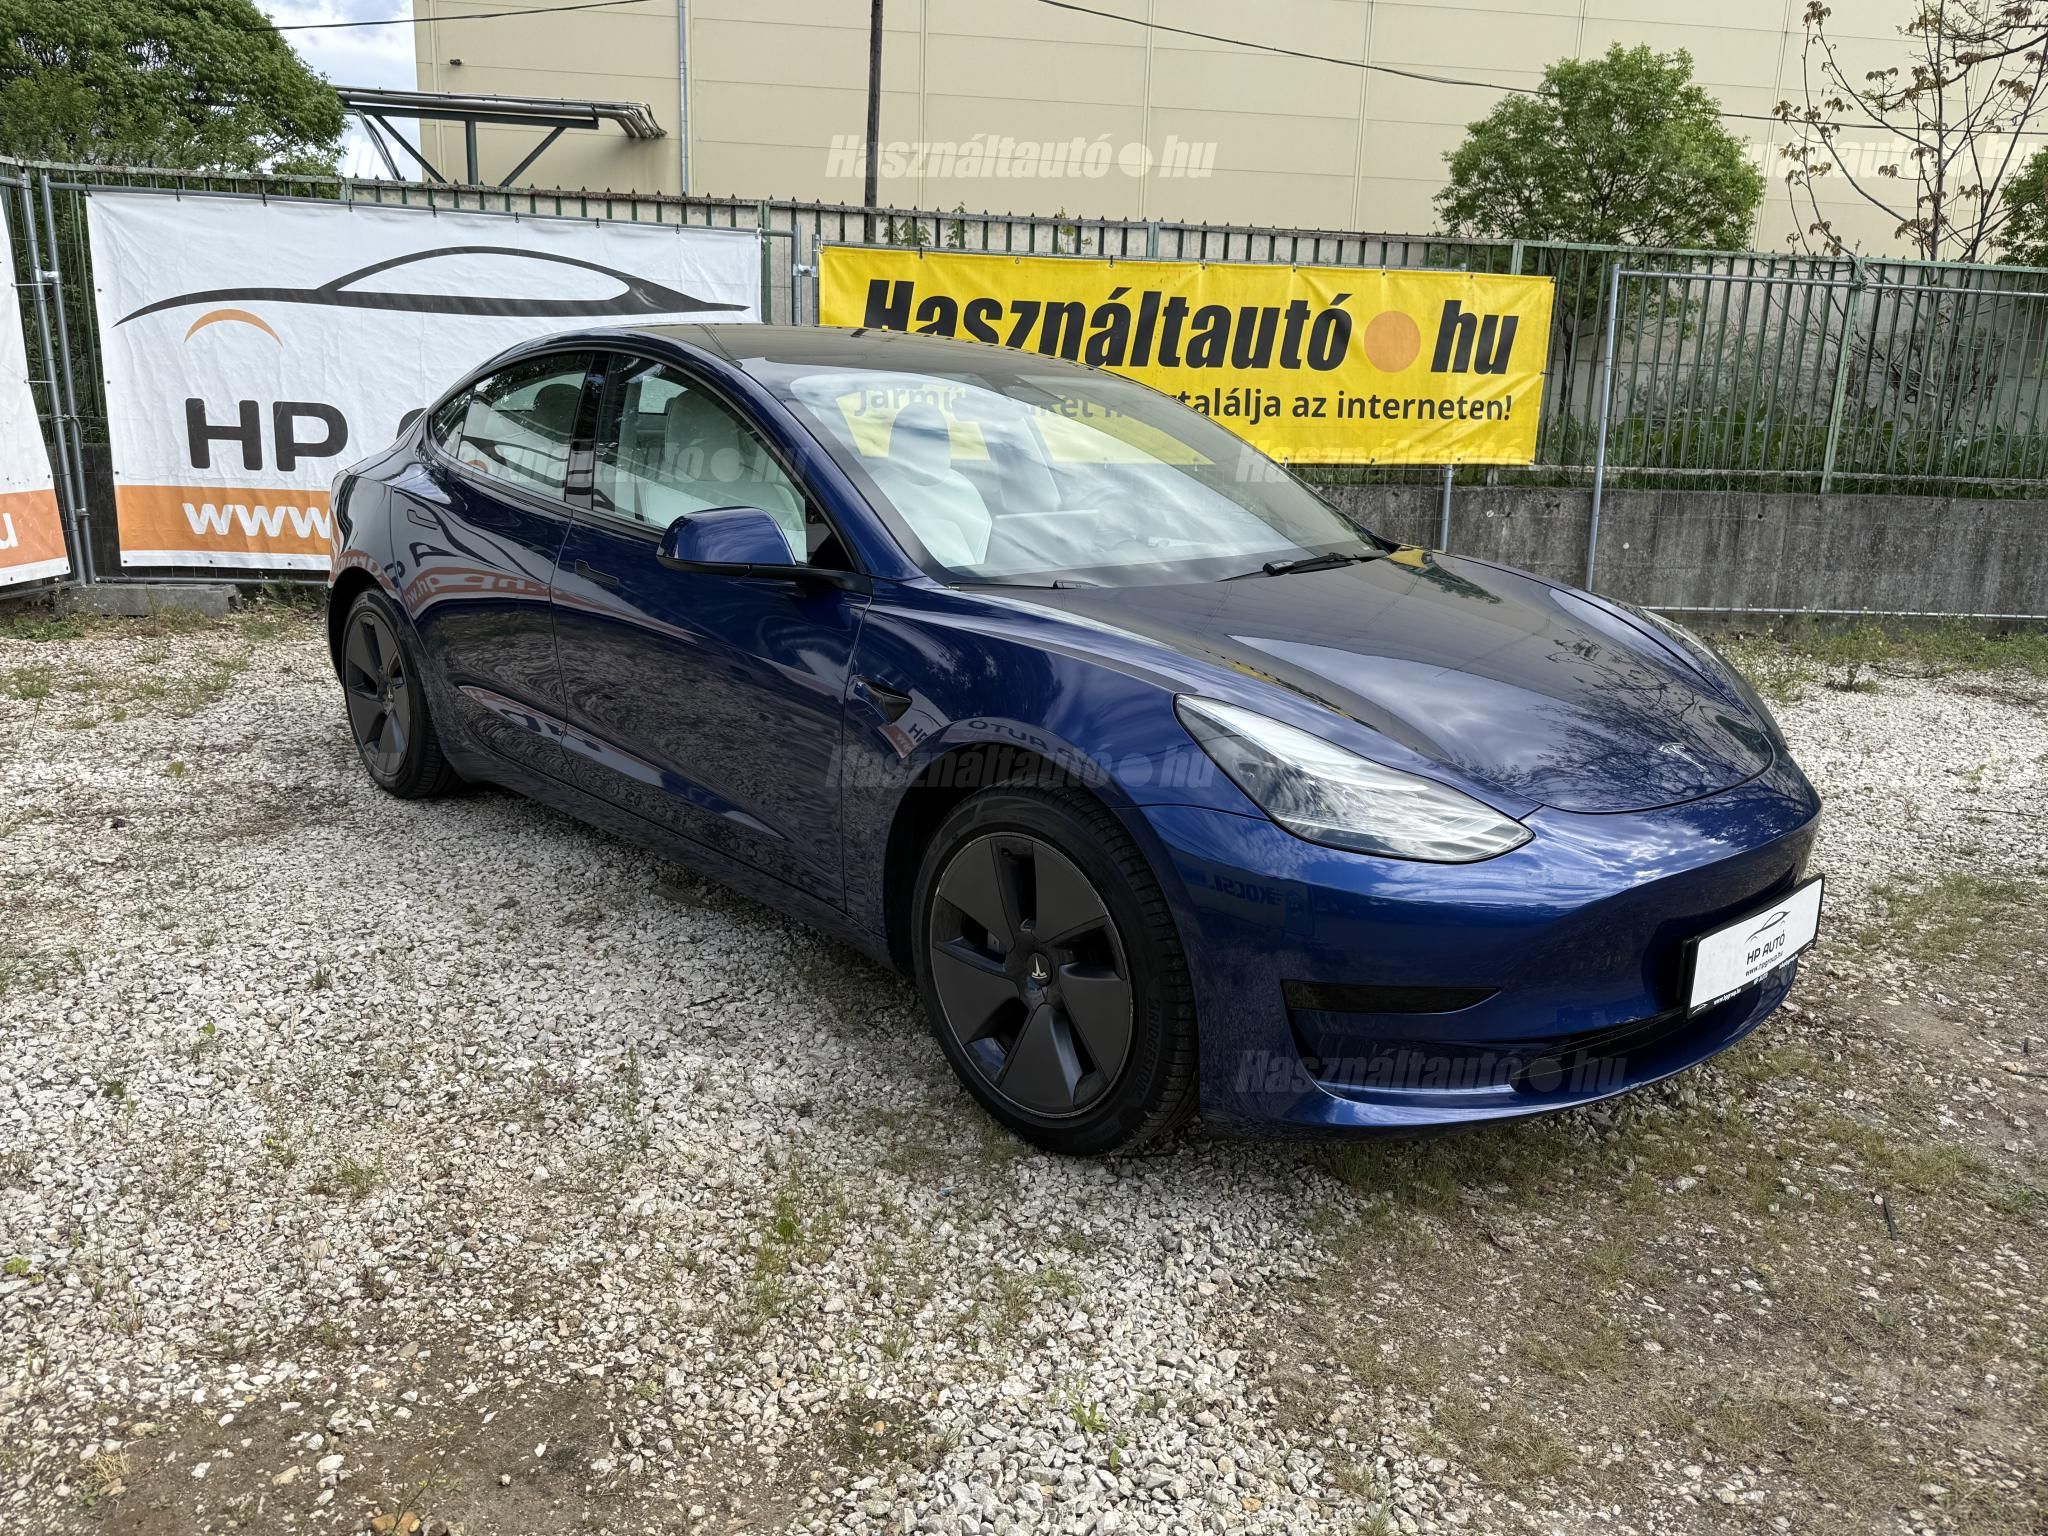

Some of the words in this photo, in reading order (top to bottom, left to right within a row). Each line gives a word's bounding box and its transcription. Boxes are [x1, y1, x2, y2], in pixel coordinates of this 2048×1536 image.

[863, 279, 1354, 372] Használtautó
[1430, 299, 1519, 375] hu
[1292, 396, 1327, 418] az
[1336, 391, 1511, 422] interneten!
[186, 398, 348, 472] HP
[1746, 947, 1761, 966] HP
[1762, 930, 1785, 958] AUTÓ
